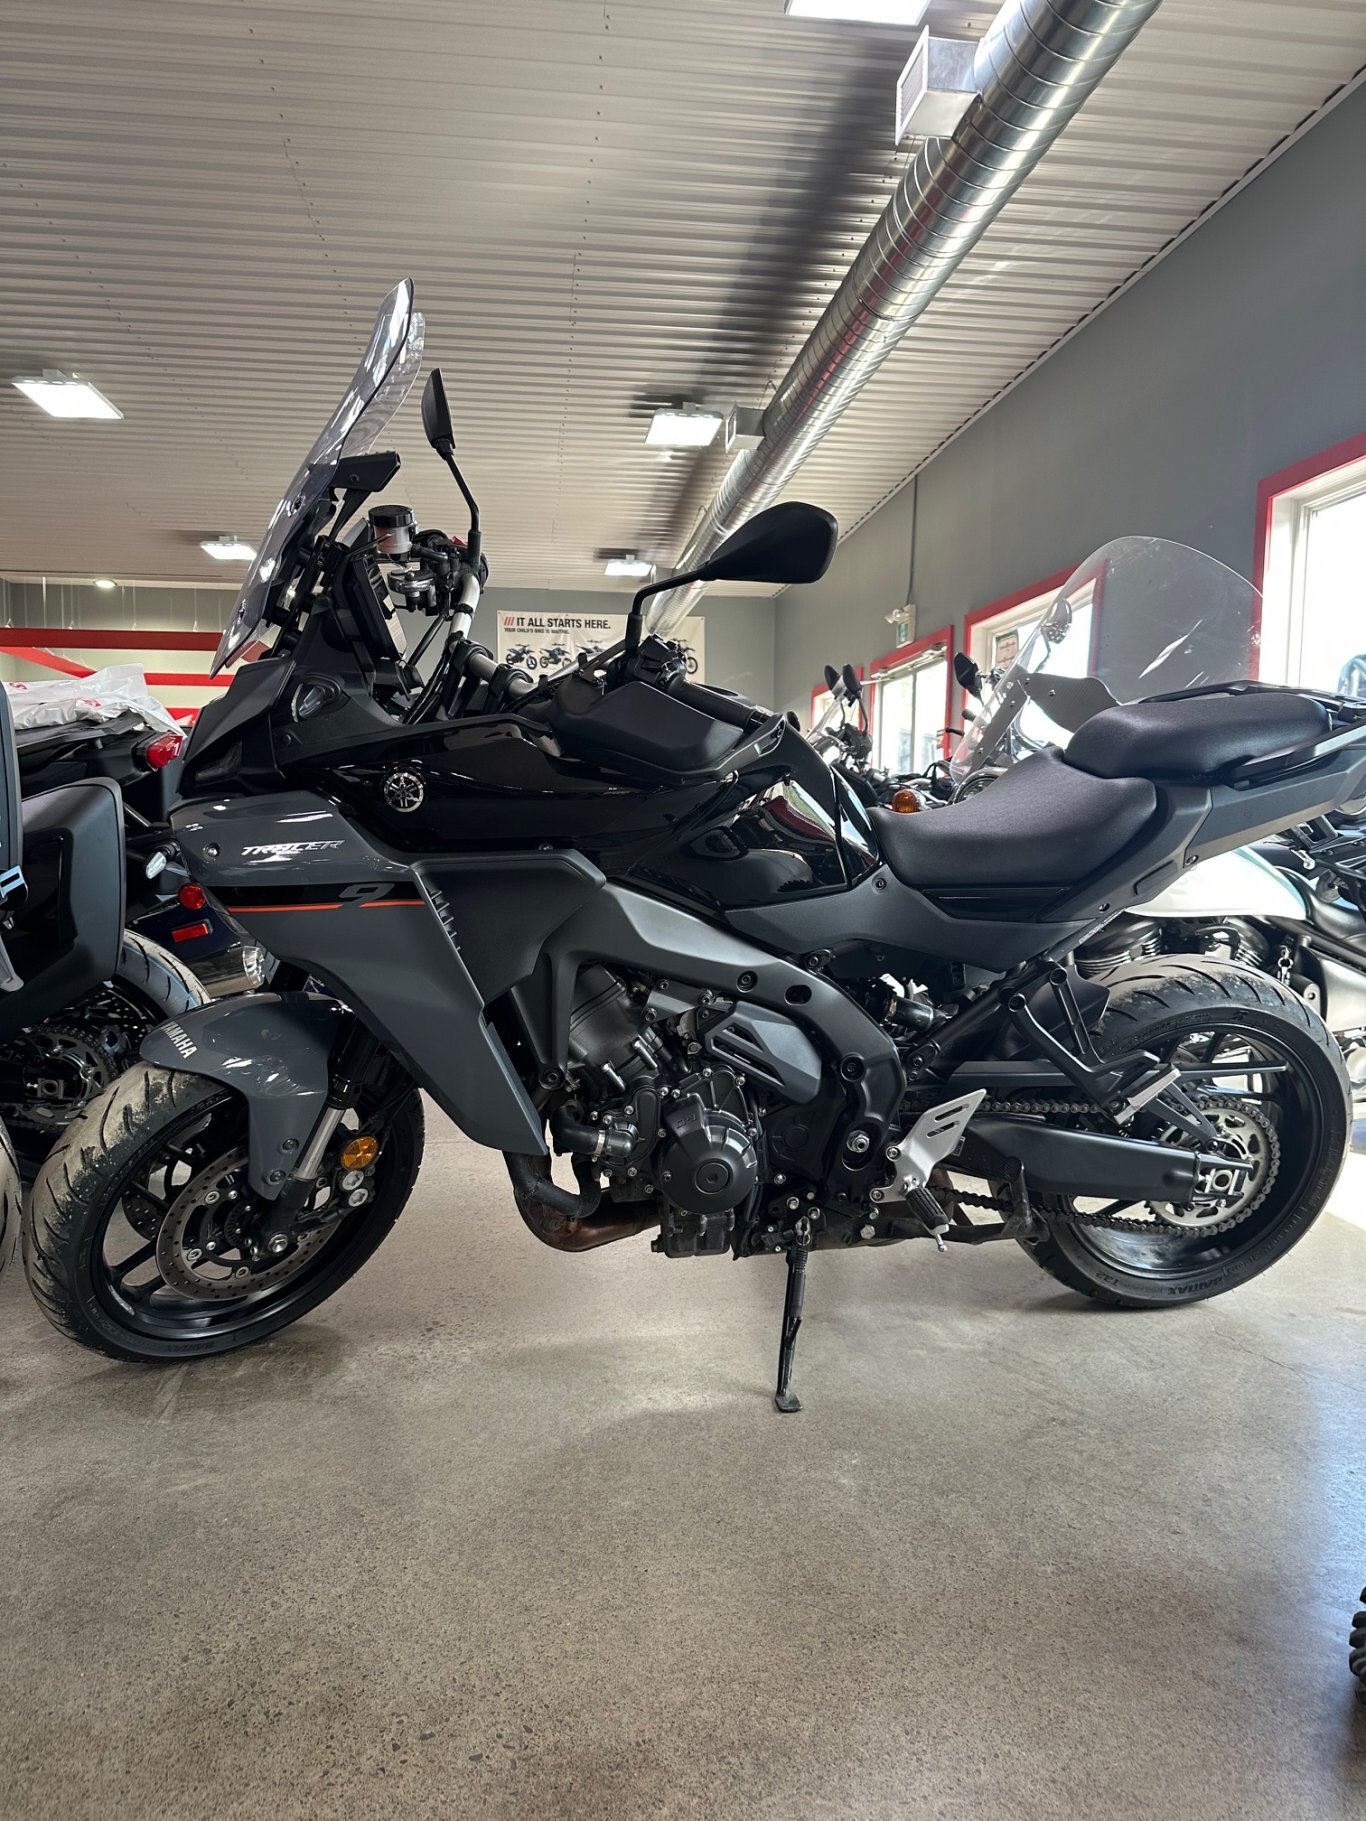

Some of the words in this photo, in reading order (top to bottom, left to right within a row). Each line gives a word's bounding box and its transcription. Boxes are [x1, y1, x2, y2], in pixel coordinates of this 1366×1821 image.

[516, 617, 525, 627] IT
[527, 617, 545, 628] ALL
[547, 618, 582, 629] STARTS
[584, 619, 611, 630] HERE.
[241, 839, 345, 856] TRACER
[339, 883, 396, 908] 9
[160, 1020, 198, 1059] YAMAHA
